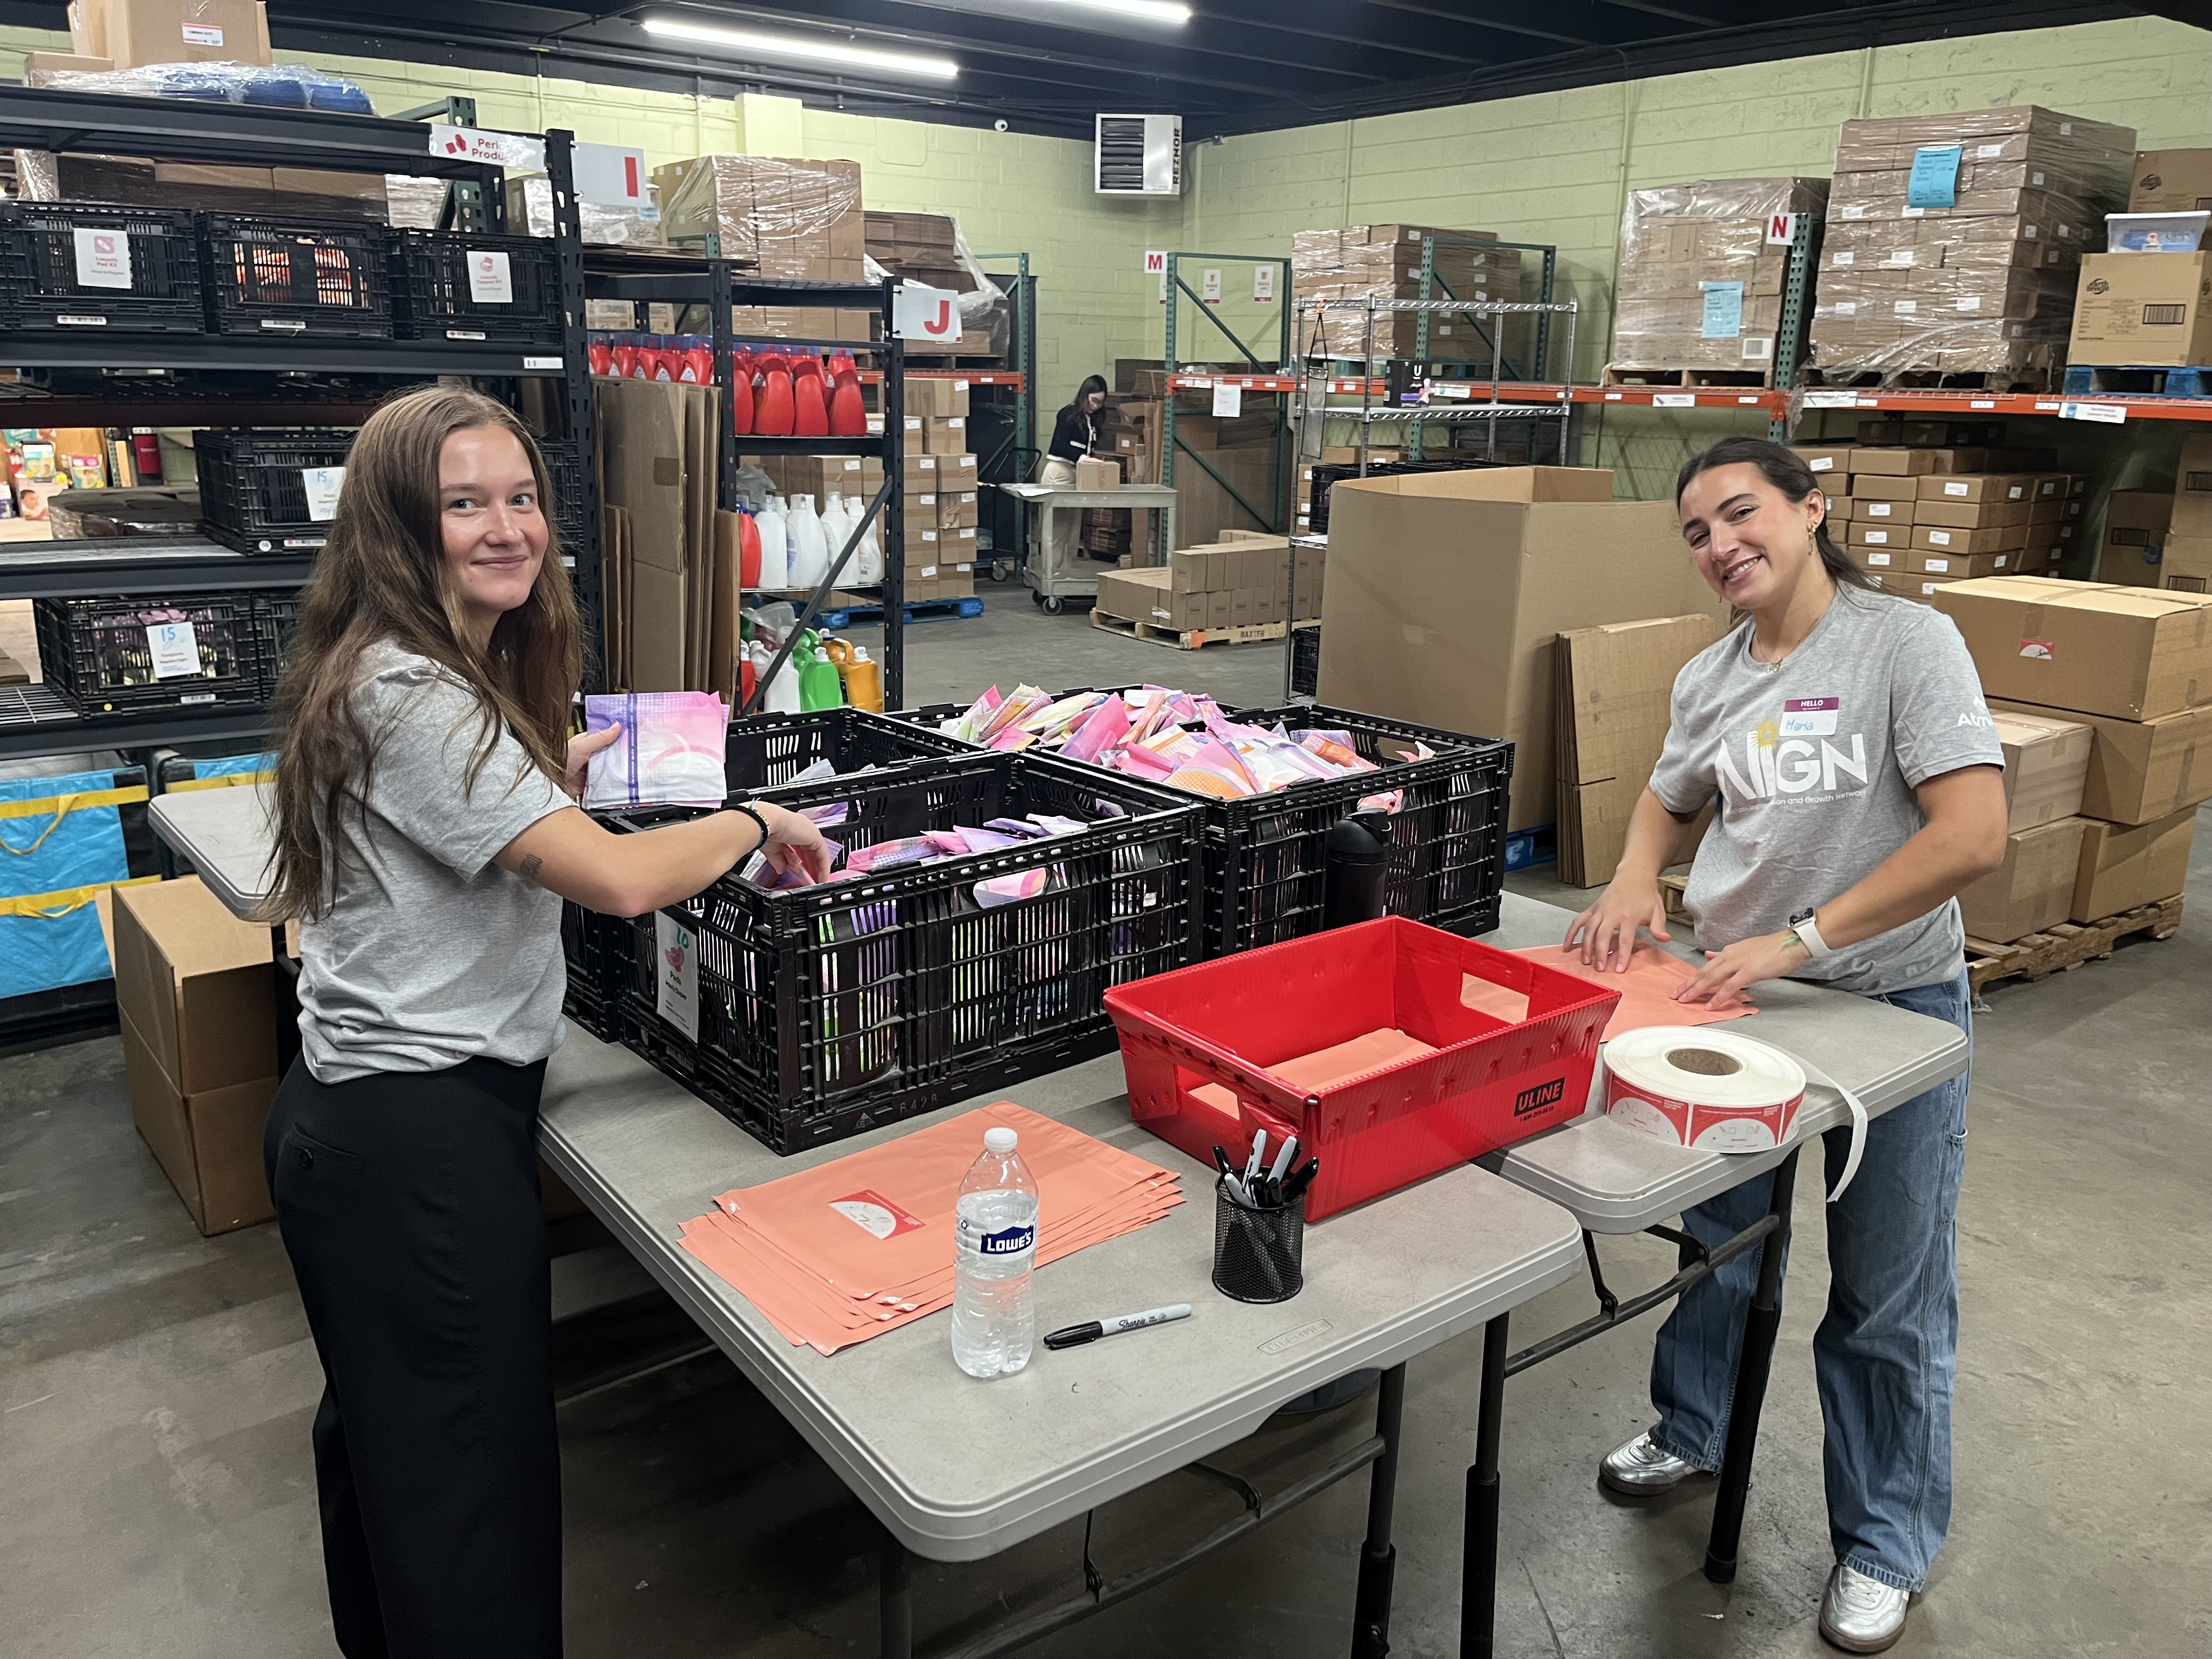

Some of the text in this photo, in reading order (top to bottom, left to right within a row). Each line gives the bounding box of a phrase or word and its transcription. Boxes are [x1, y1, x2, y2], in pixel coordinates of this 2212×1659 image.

[1771, 216, 1788, 238] N
[1148, 255, 1163, 270] M
[924, 300, 950, 335] J
[1414, 365, 1422, 376] U
[161, 627, 176, 642] 15
[1240, 630, 1265, 638] BAXTER
[1804, 794, 1834, 804] Growth
[1836, 789, 1867, 799] Network
[677, 927, 689, 949] 10
[1518, 1081, 1561, 1111] ULINE
[987, 1231, 1032, 1252] LOWE'S
[1119, 1317, 1146, 1329] Sharpie
